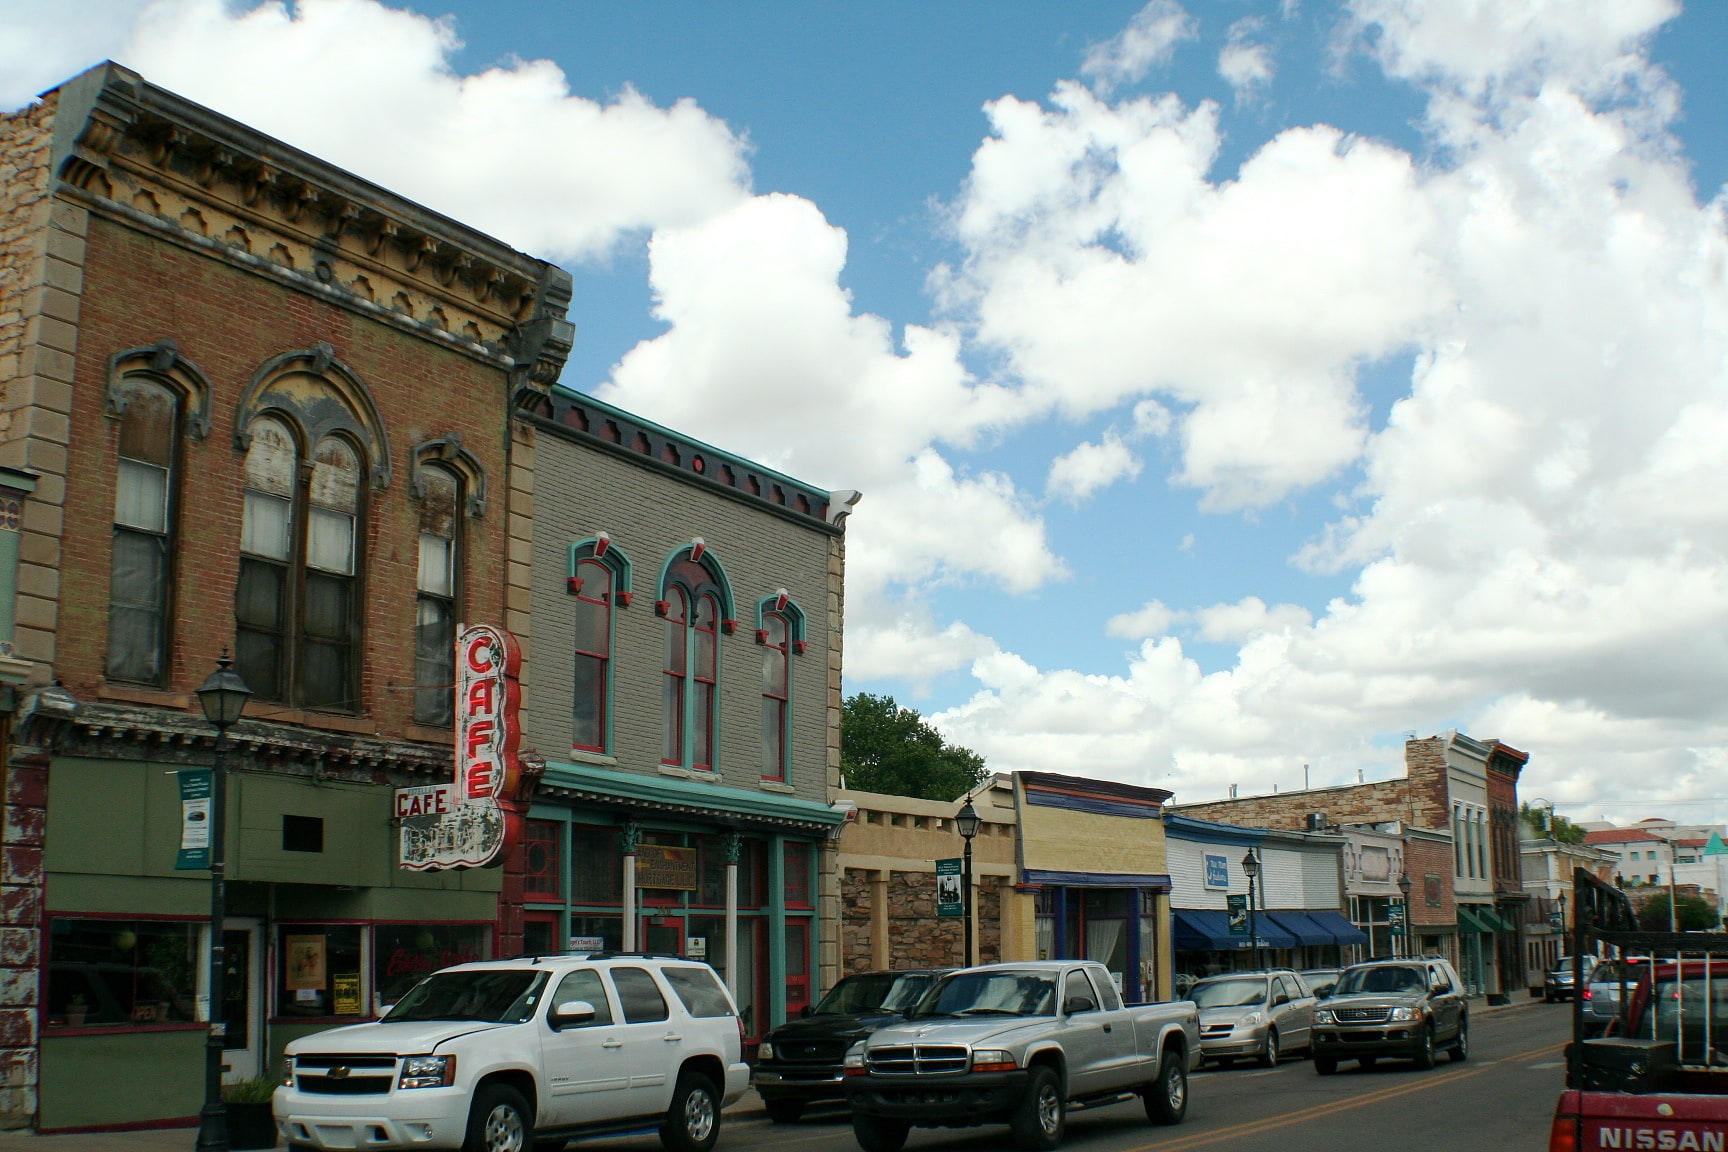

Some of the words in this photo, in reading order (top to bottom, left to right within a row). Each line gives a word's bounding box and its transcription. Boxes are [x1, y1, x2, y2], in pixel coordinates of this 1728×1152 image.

[466, 635, 497, 800] CAFE
[397, 789, 446, 817] CAFE
[1599, 1127, 1725, 1152] NISSAN
